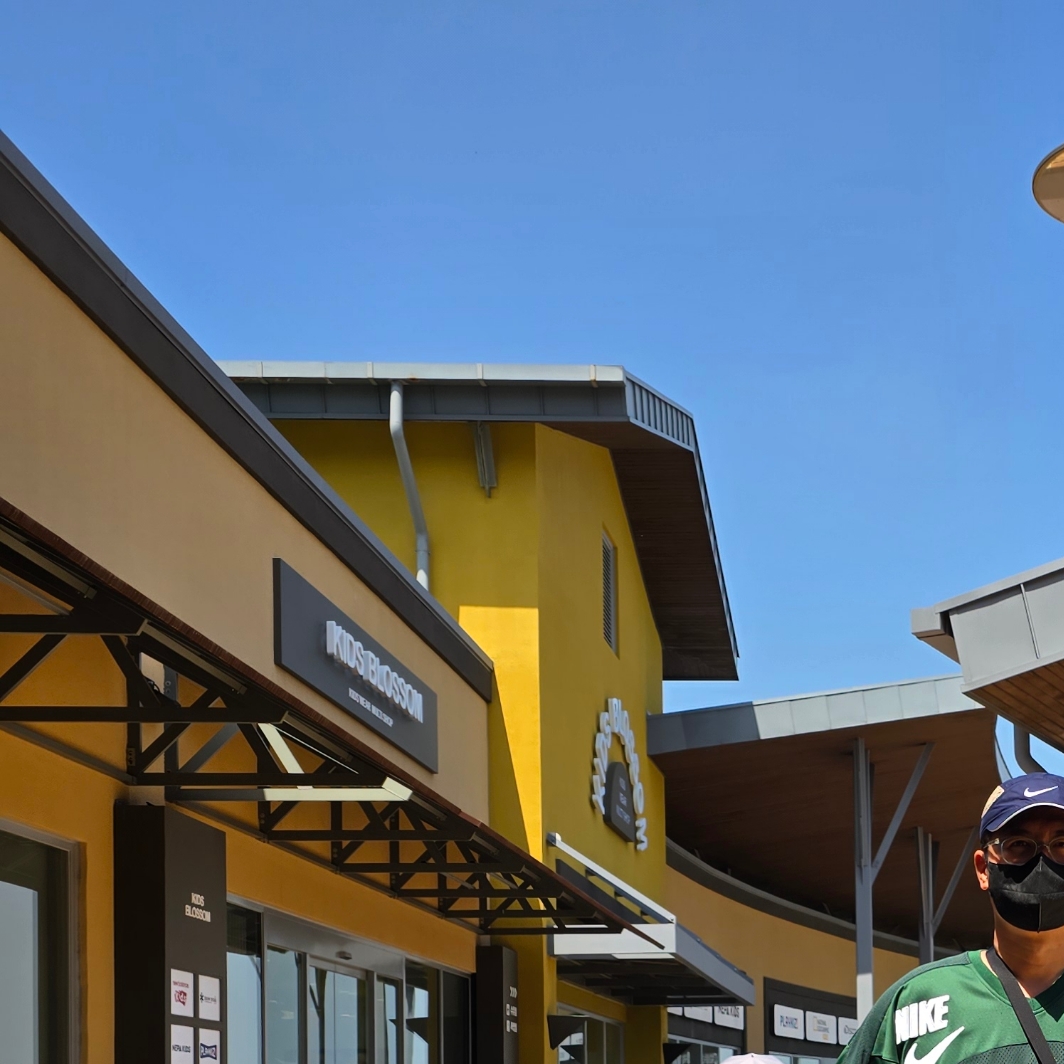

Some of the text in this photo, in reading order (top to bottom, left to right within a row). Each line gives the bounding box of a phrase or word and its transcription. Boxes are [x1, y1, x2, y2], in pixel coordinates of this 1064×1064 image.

[326, 620, 423, 724] KIDS BLOSSOM
[184, 904, 211, 923] BLOSSOM
[191, 892, 205, 907] KIDS
[894, 994, 950, 1045] NIKE
